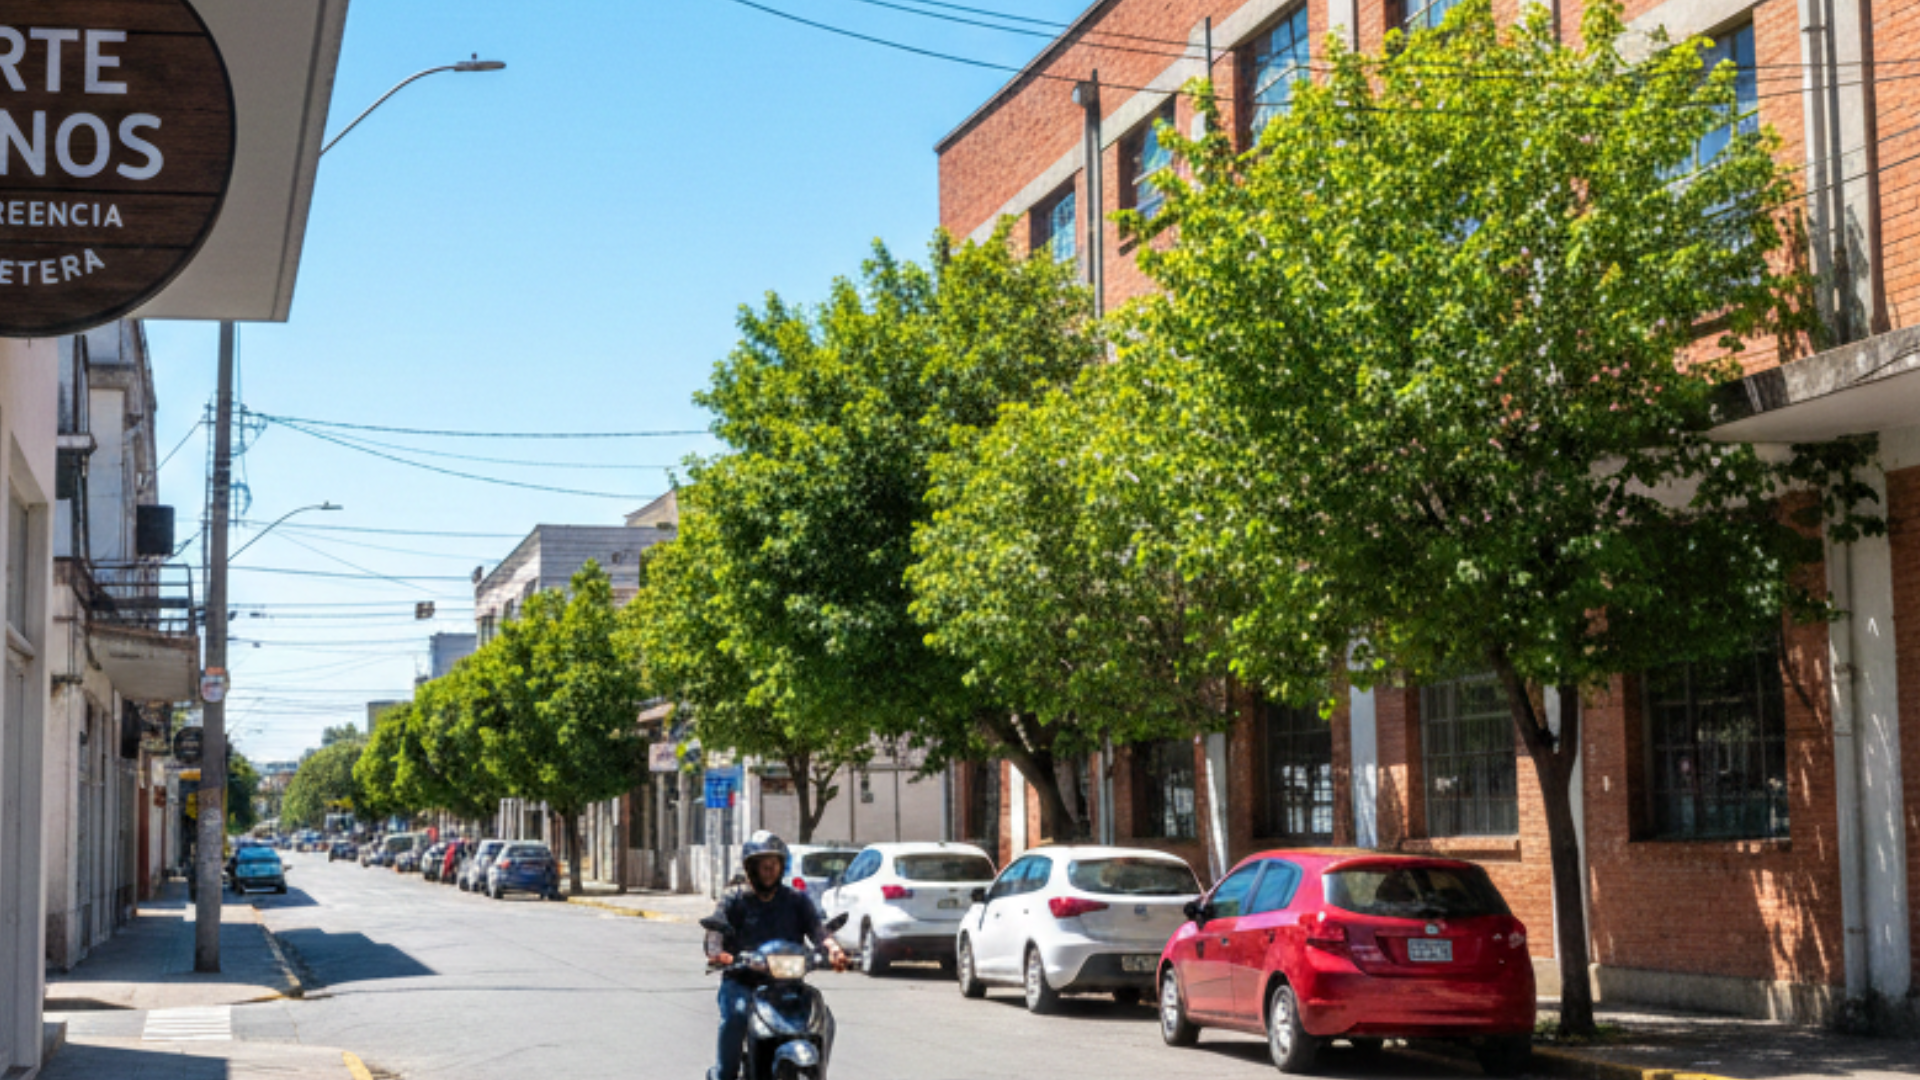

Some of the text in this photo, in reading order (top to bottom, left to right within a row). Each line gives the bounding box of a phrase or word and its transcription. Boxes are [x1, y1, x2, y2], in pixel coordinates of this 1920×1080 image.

[0, 26, 127, 94] RTE
[0, 109, 164, 180] NOS
[0, 201, 123, 228] EENCIA
[0, 248, 105, 285] ETERA
